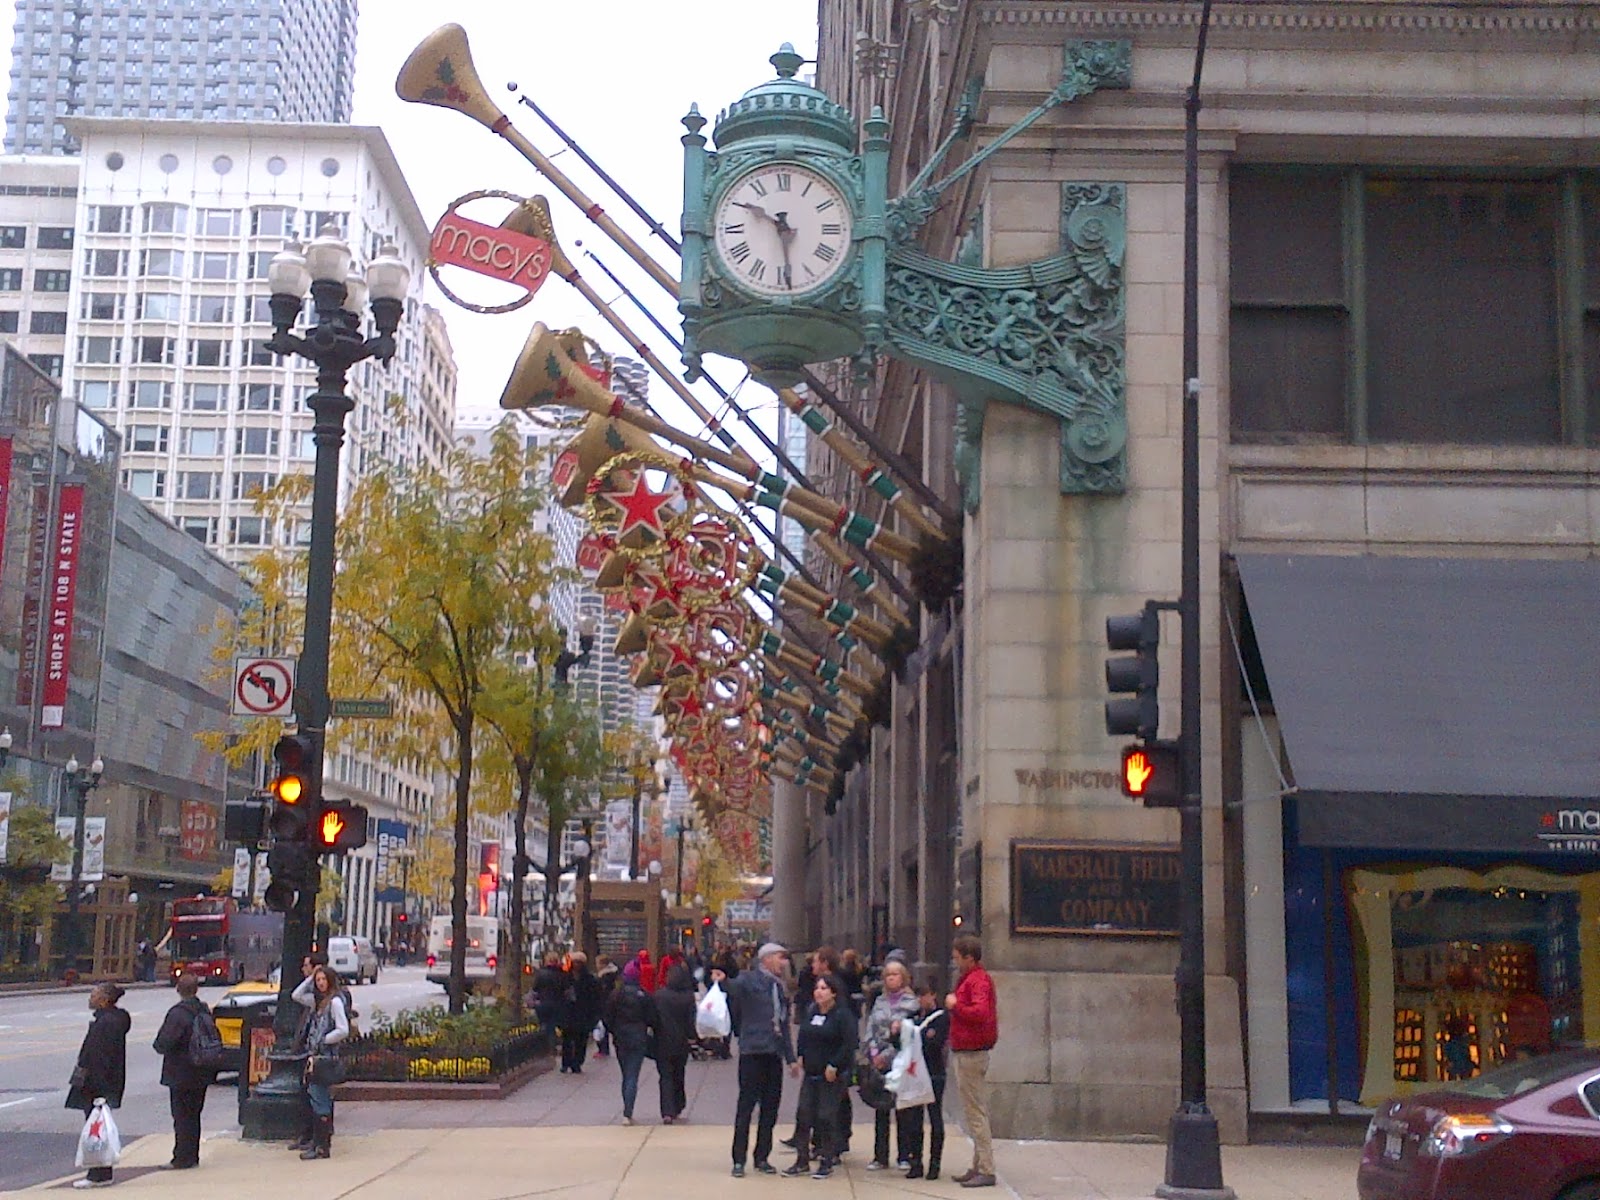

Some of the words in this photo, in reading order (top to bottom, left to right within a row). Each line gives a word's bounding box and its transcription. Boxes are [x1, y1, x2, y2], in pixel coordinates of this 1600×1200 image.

[435, 223, 545, 280] macy's
[60, 511, 77, 556] STATE
[58, 559, 71, 571] N
[56, 575, 71, 603] 108
[52, 608, 68, 628] AT
[49, 632, 65, 681] SHOPS
[1030, 854, 1121, 879] MARSHALL
[1060, 899, 1152, 925] COMPANY
